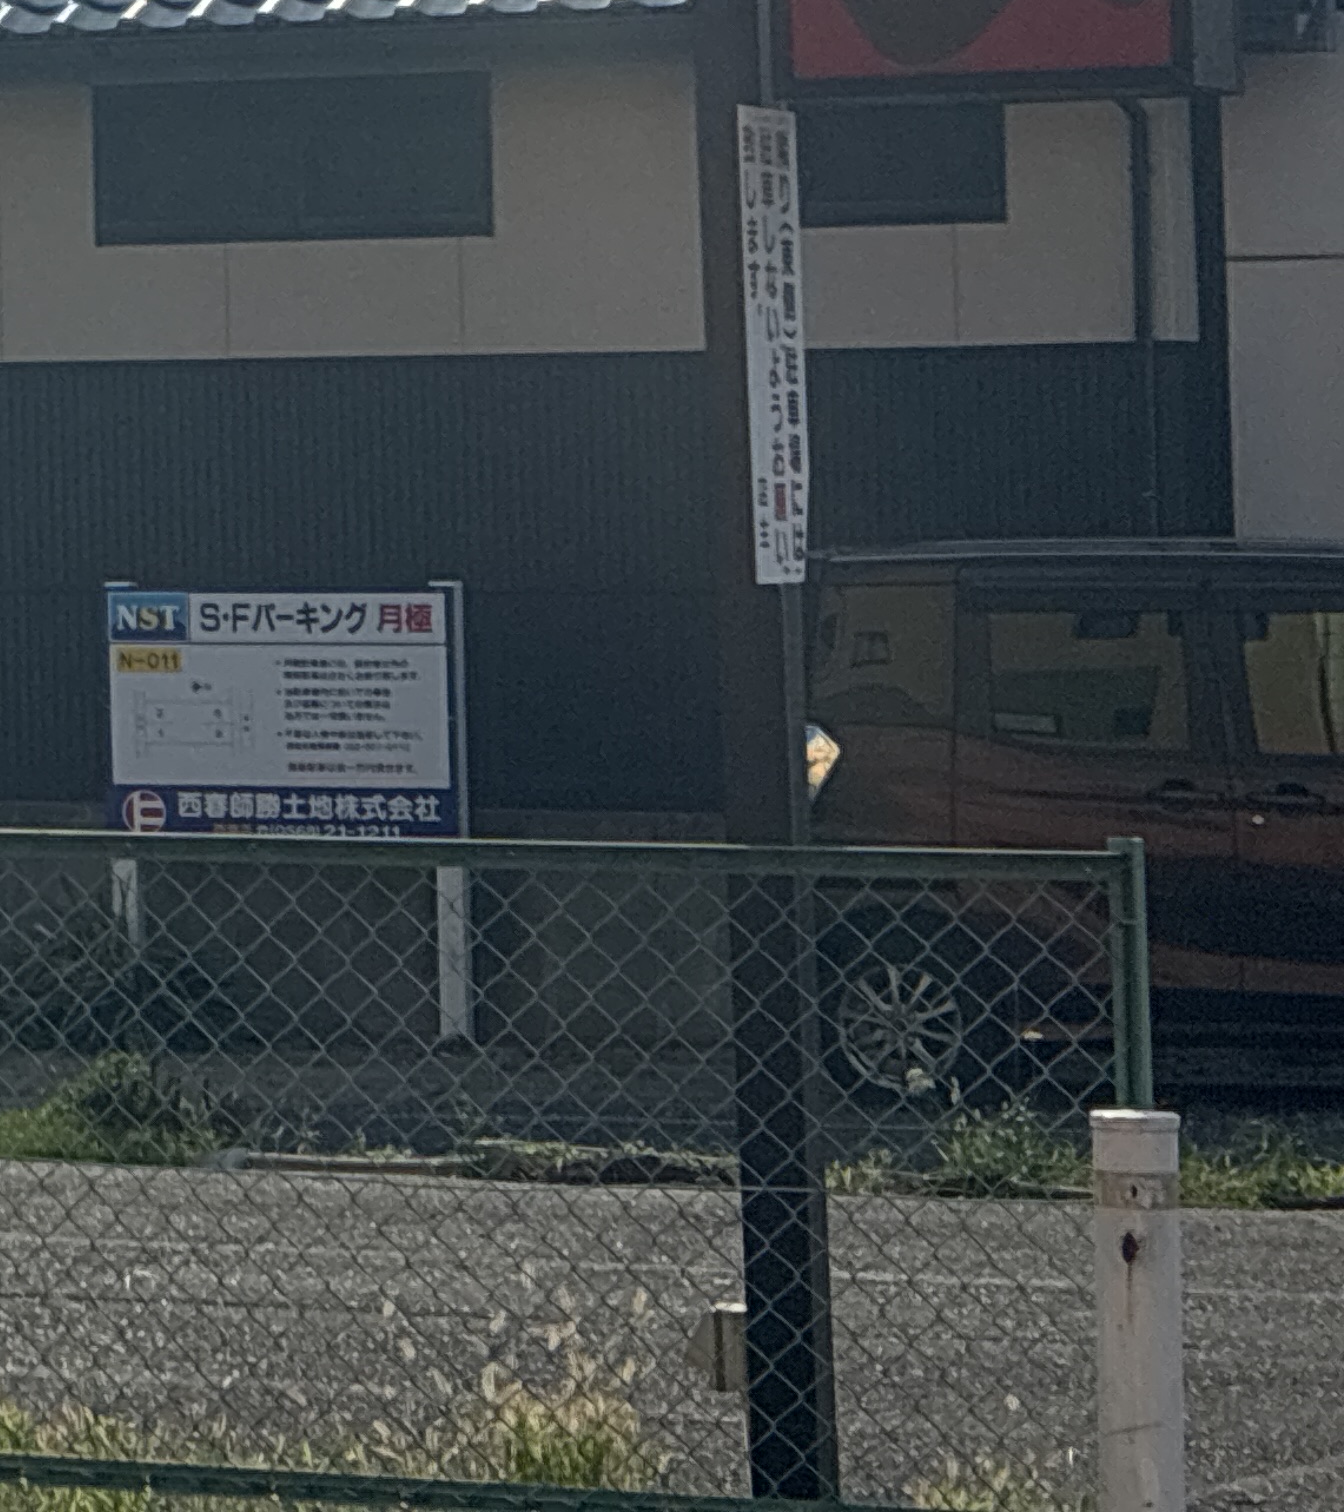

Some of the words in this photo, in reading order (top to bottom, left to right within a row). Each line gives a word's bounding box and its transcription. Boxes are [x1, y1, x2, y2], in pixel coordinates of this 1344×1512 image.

[116, 605, 179, 632] NST
[377, 603, 433, 633] 月極
[117, 653, 180, 670] N-011
[177, 793, 441, 823] 西春師勝土地株式会社
